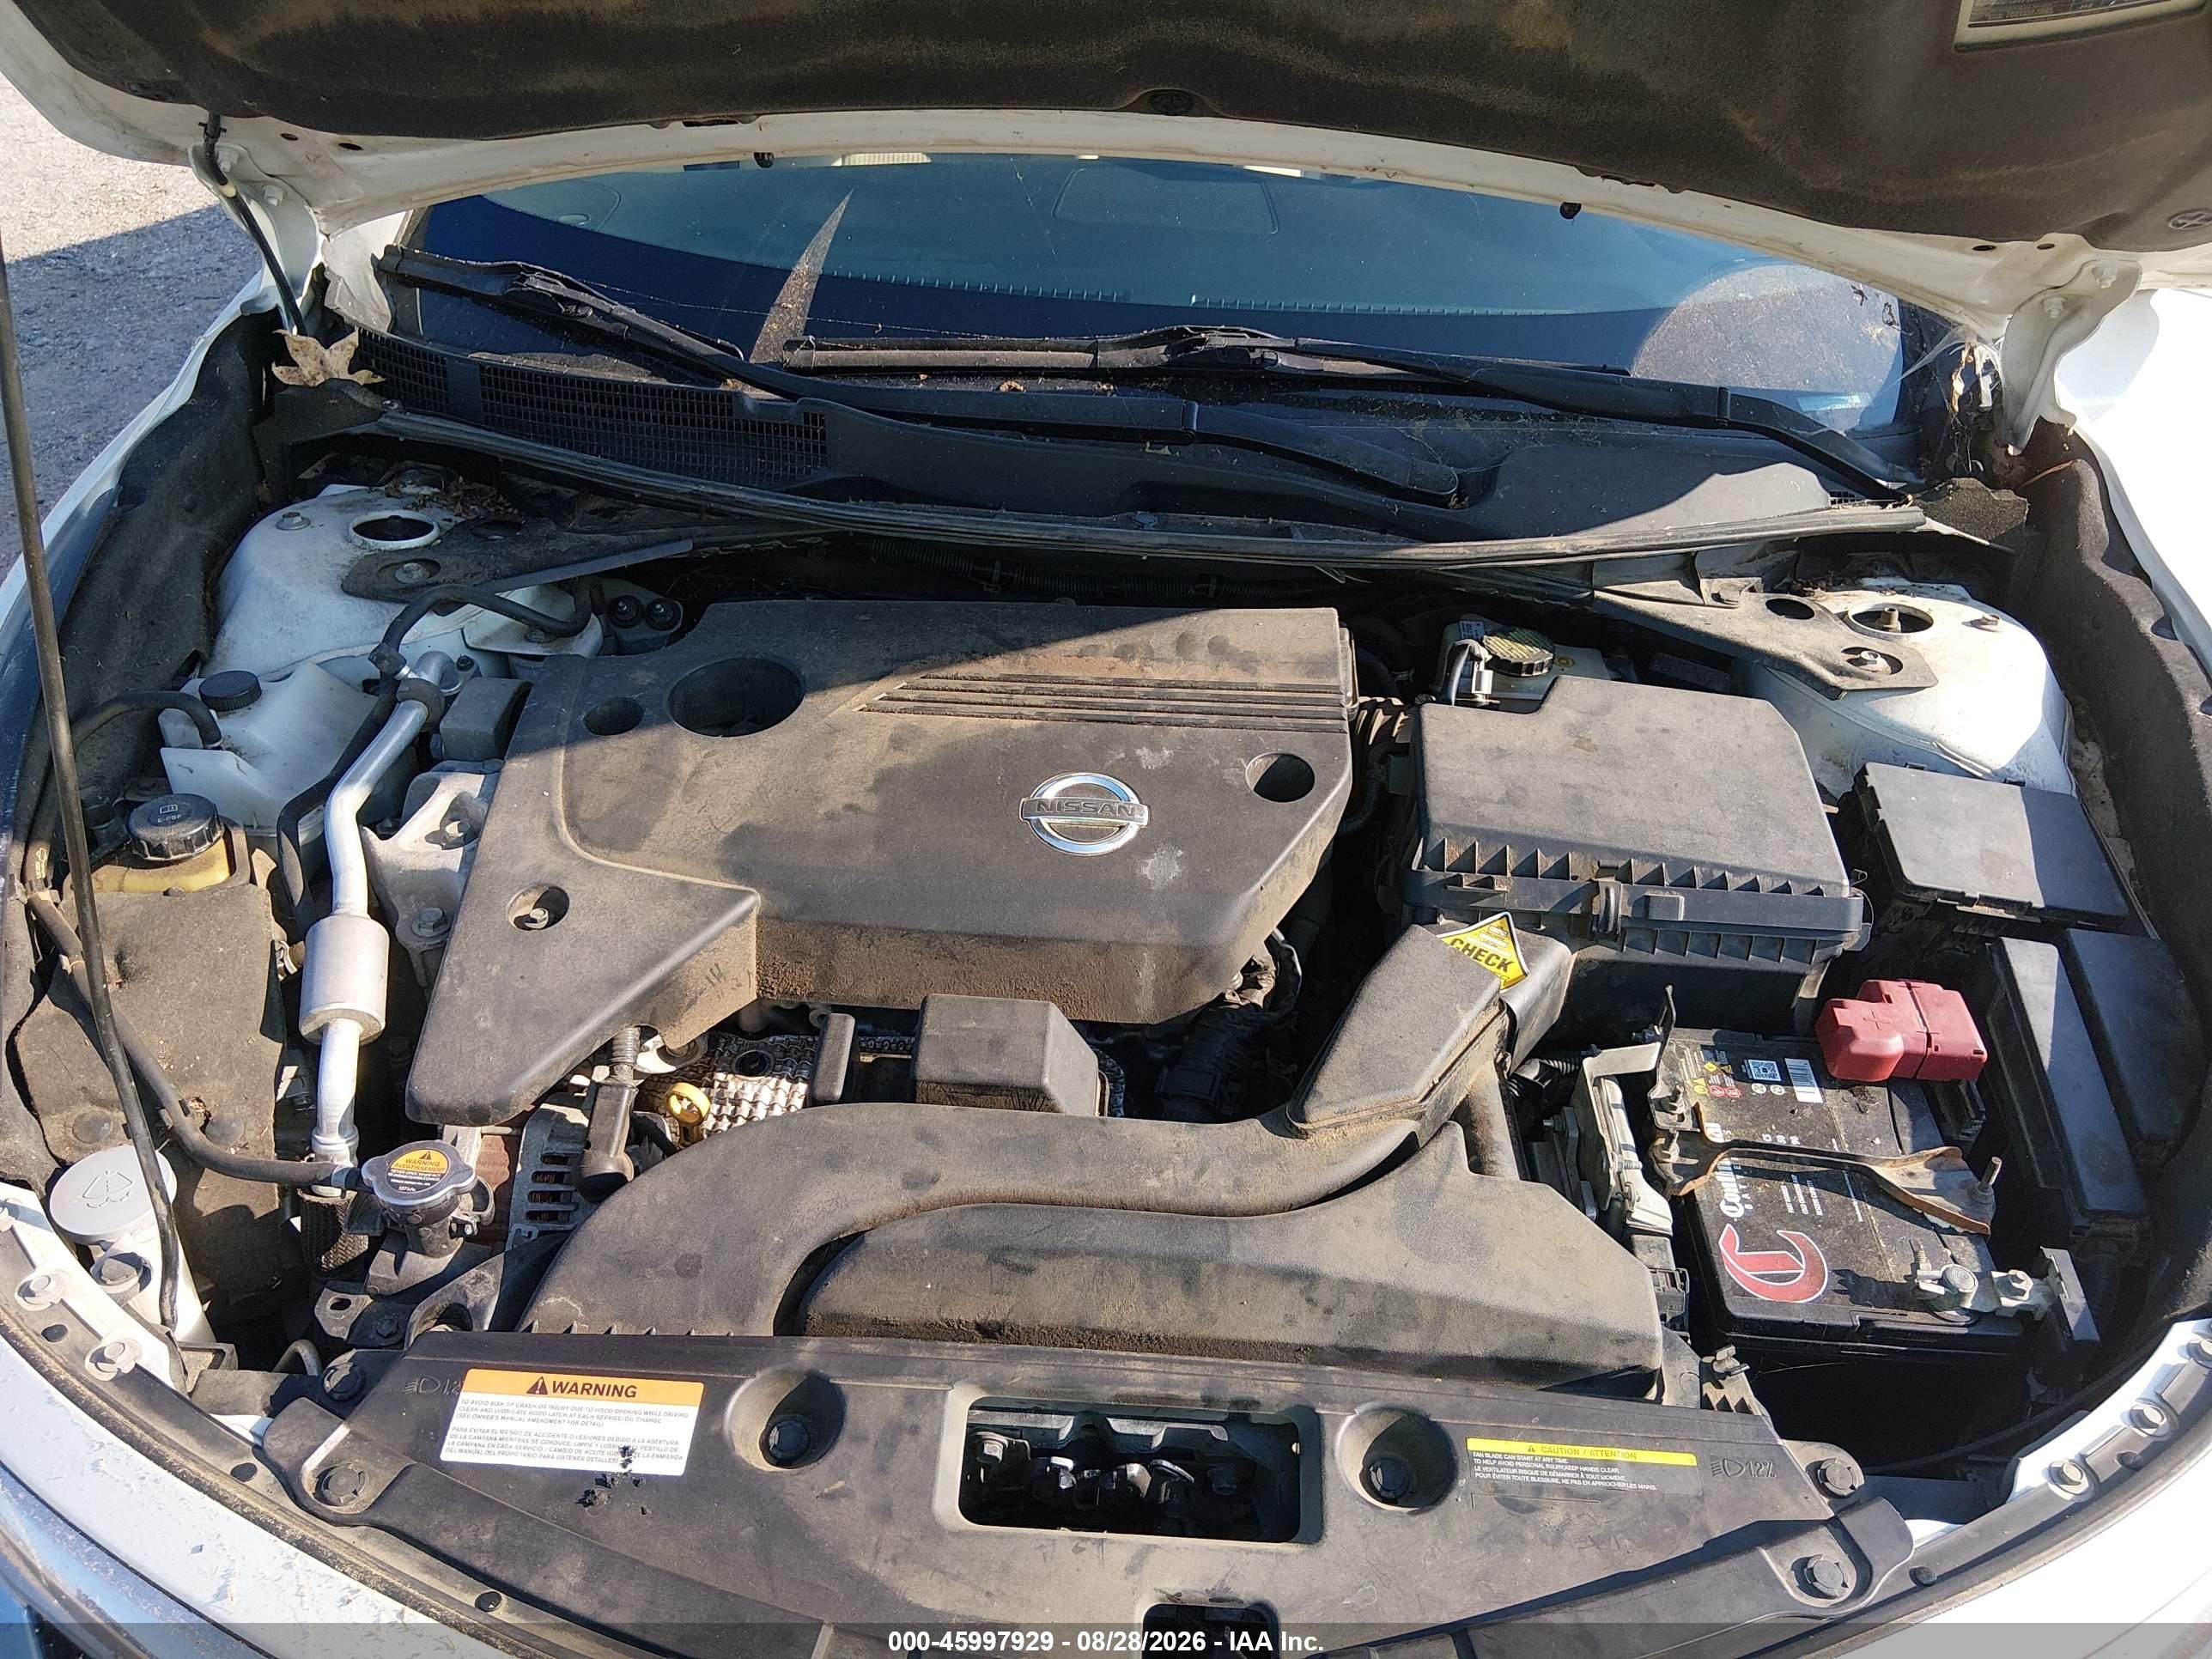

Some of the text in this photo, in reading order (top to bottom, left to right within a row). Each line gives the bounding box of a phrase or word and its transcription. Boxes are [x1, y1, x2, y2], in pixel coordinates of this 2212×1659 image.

[1036, 801, 1133, 817] NISSAN
[1450, 938, 1515, 973] CHECK
[405, 1158, 440, 1166] WARNING
[551, 1380, 637, 1398] WARNING
[1540, 1446, 1580, 1455] CAUTION
[1589, 1449, 1637, 1459] ATTENTION
